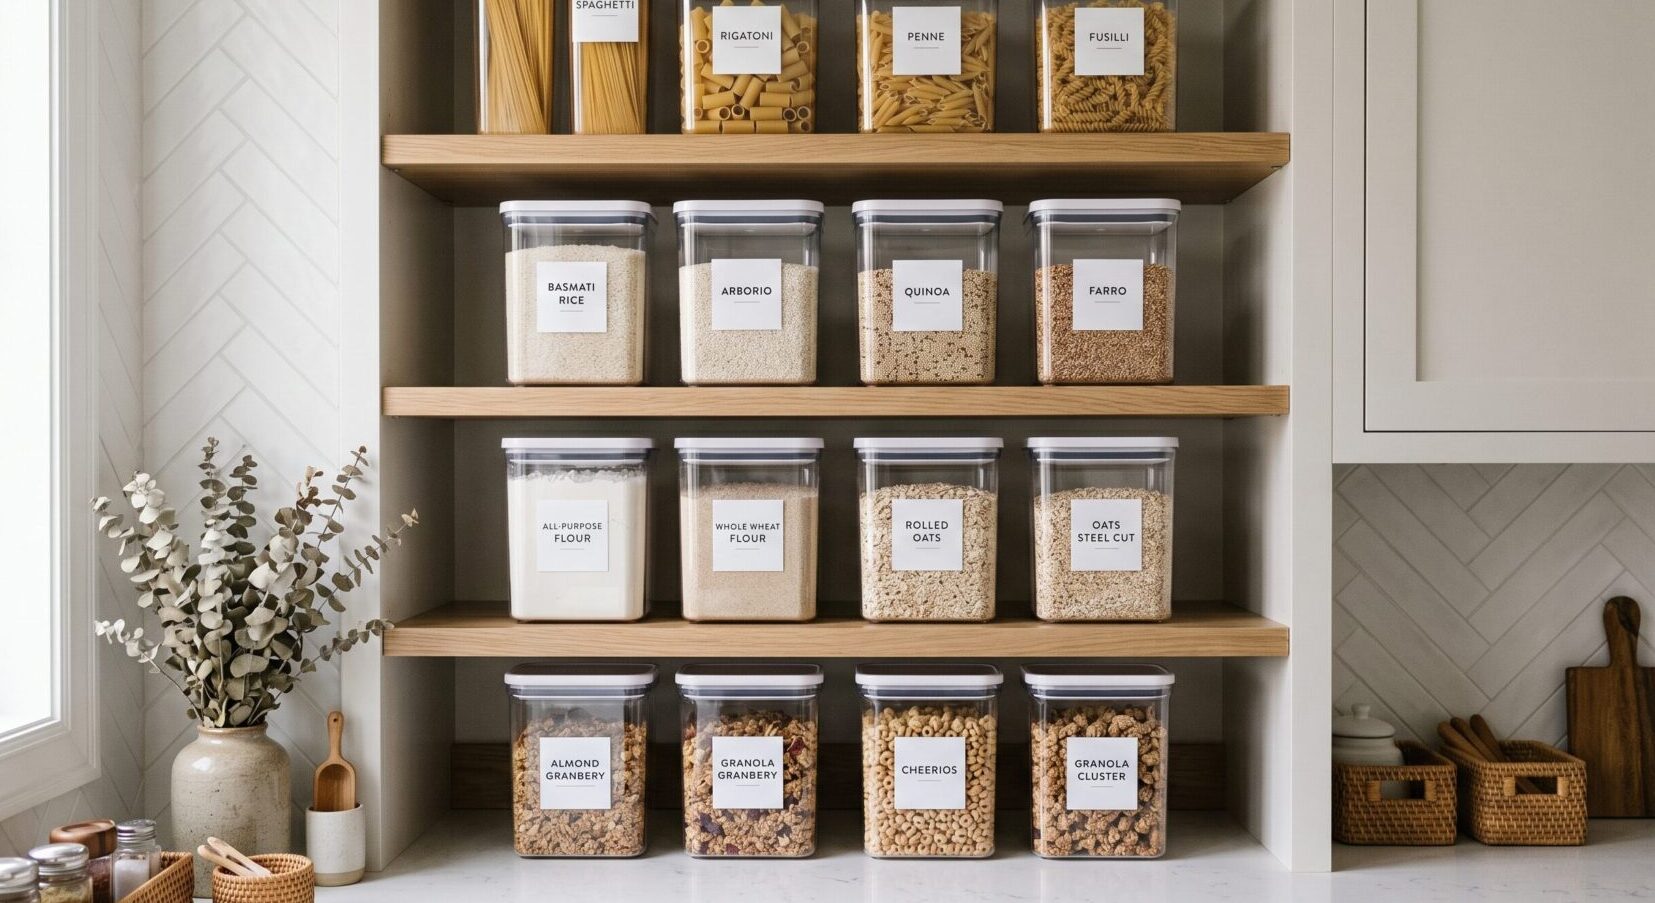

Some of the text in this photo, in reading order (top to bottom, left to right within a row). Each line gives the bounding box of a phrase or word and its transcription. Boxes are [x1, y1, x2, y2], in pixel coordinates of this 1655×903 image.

[577, 1, 634, 9] SPAGHETTI
[721, 32, 773, 41] RIGATONI
[908, 33, 945, 42] PENNE
[1090, 33, 1129, 42] FUSILLI
[548, 283, 595, 292] BASMATI
[721, 287, 772, 296] ARBORIO
[1089, 287, 1127, 296] FARRO
[905, 287, 950, 299] QUINOA
[559, 296, 585, 305] RICE
[716, 523, 747, 531] WHOLE
[905, 521, 949, 530] ROLLED
[1092, 521, 1121, 530] OATS
[554, 534, 591, 543] FLOUR
[730, 534, 766, 543] FLOUR
[913, 534, 941, 543] OATS
[1077, 534, 1136, 543] STEEL CUT
[550, 759, 600, 768] ALMOND
[720, 759, 775, 768] GRANOLA
[1074, 759, 1130, 769] GRANOLA
[901, 766, 958, 775] CHEERIOS
[545, 772, 605, 781] GRANBERY
[717, 772, 777, 780] GRANBERY
[1077, 772, 1126, 781] CLUSTER
